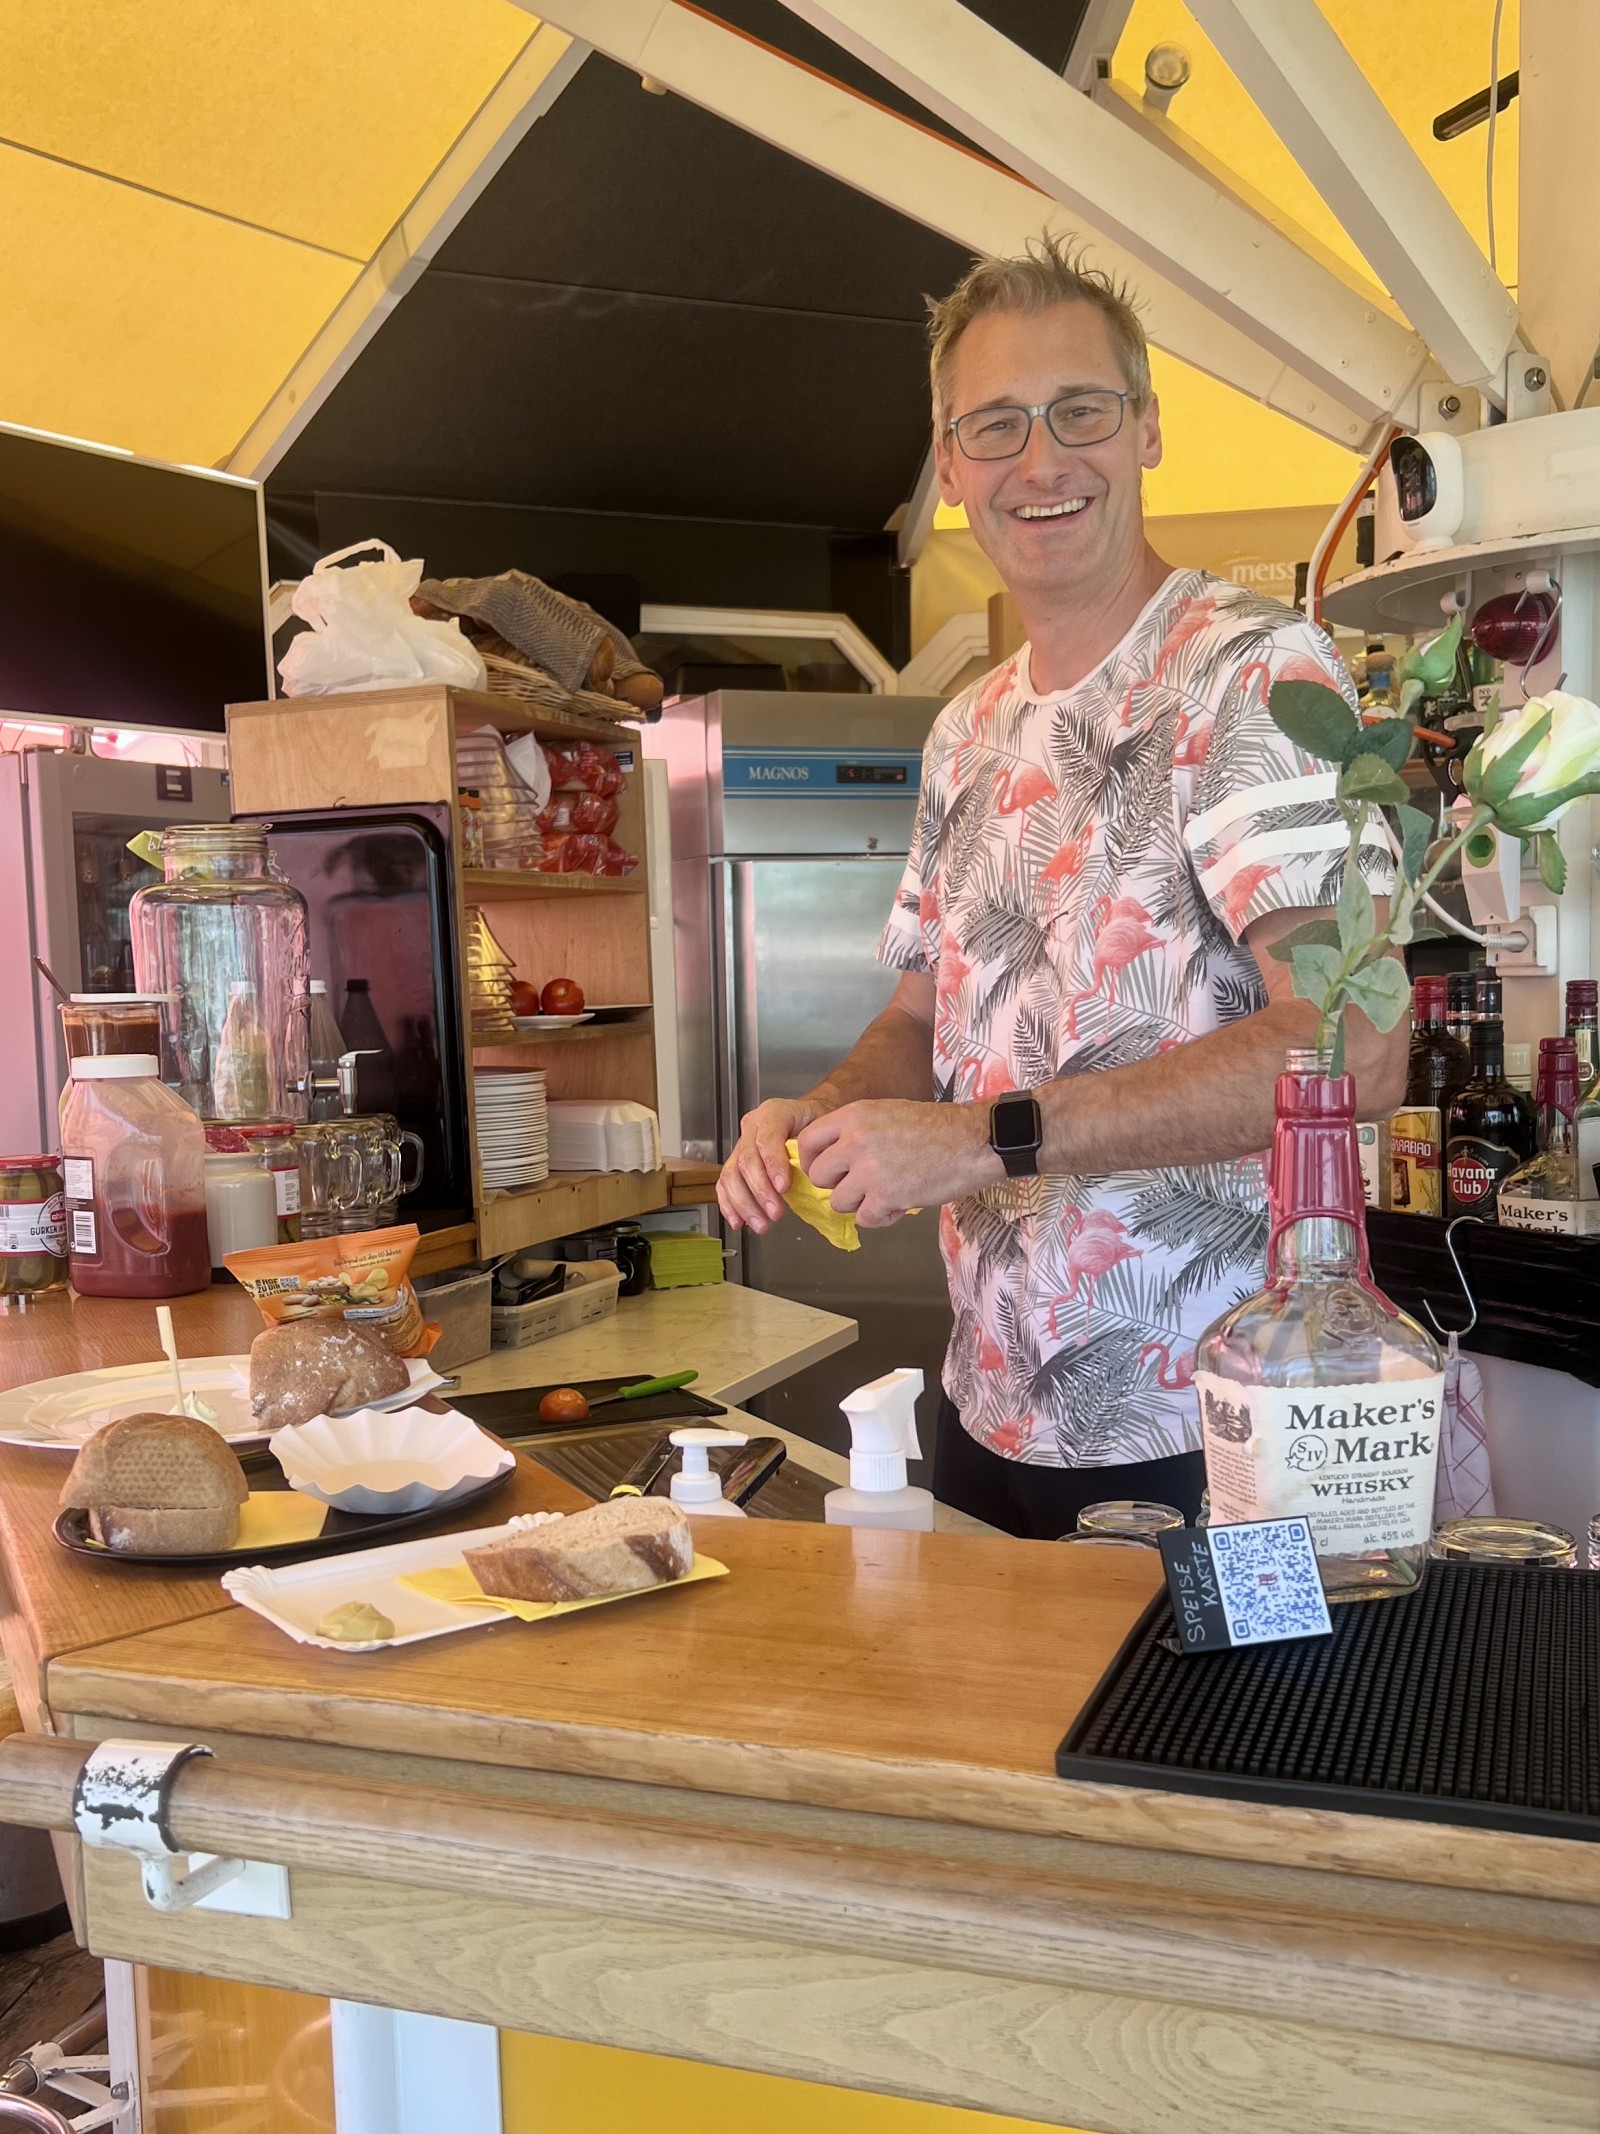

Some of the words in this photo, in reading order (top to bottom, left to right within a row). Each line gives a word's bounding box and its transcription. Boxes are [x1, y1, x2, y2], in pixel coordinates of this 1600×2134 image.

[1231, 561, 1296, 583] meiss
[749, 767, 809, 780] MAGNOS
[1448, 1163, 1496, 1180] Havana
[1453, 1180, 1482, 1195] Club
[1500, 1204, 1569, 1222] Maker's
[30, 1225, 57, 1236] GURKEN
[1285, 1398, 1436, 1430] Maker's
[1332, 1431, 1433, 1465] Mark
[1311, 1475, 1415, 1497] WHISKY
[1320, 1537, 1329, 1547] cl
[1363, 1533, 1379, 1544] alc.
[1381, 1530, 1399, 1542] 45%
[1191, 1541, 1219, 1607] KARTE
[1173, 1561, 1206, 1643] SPEISE
